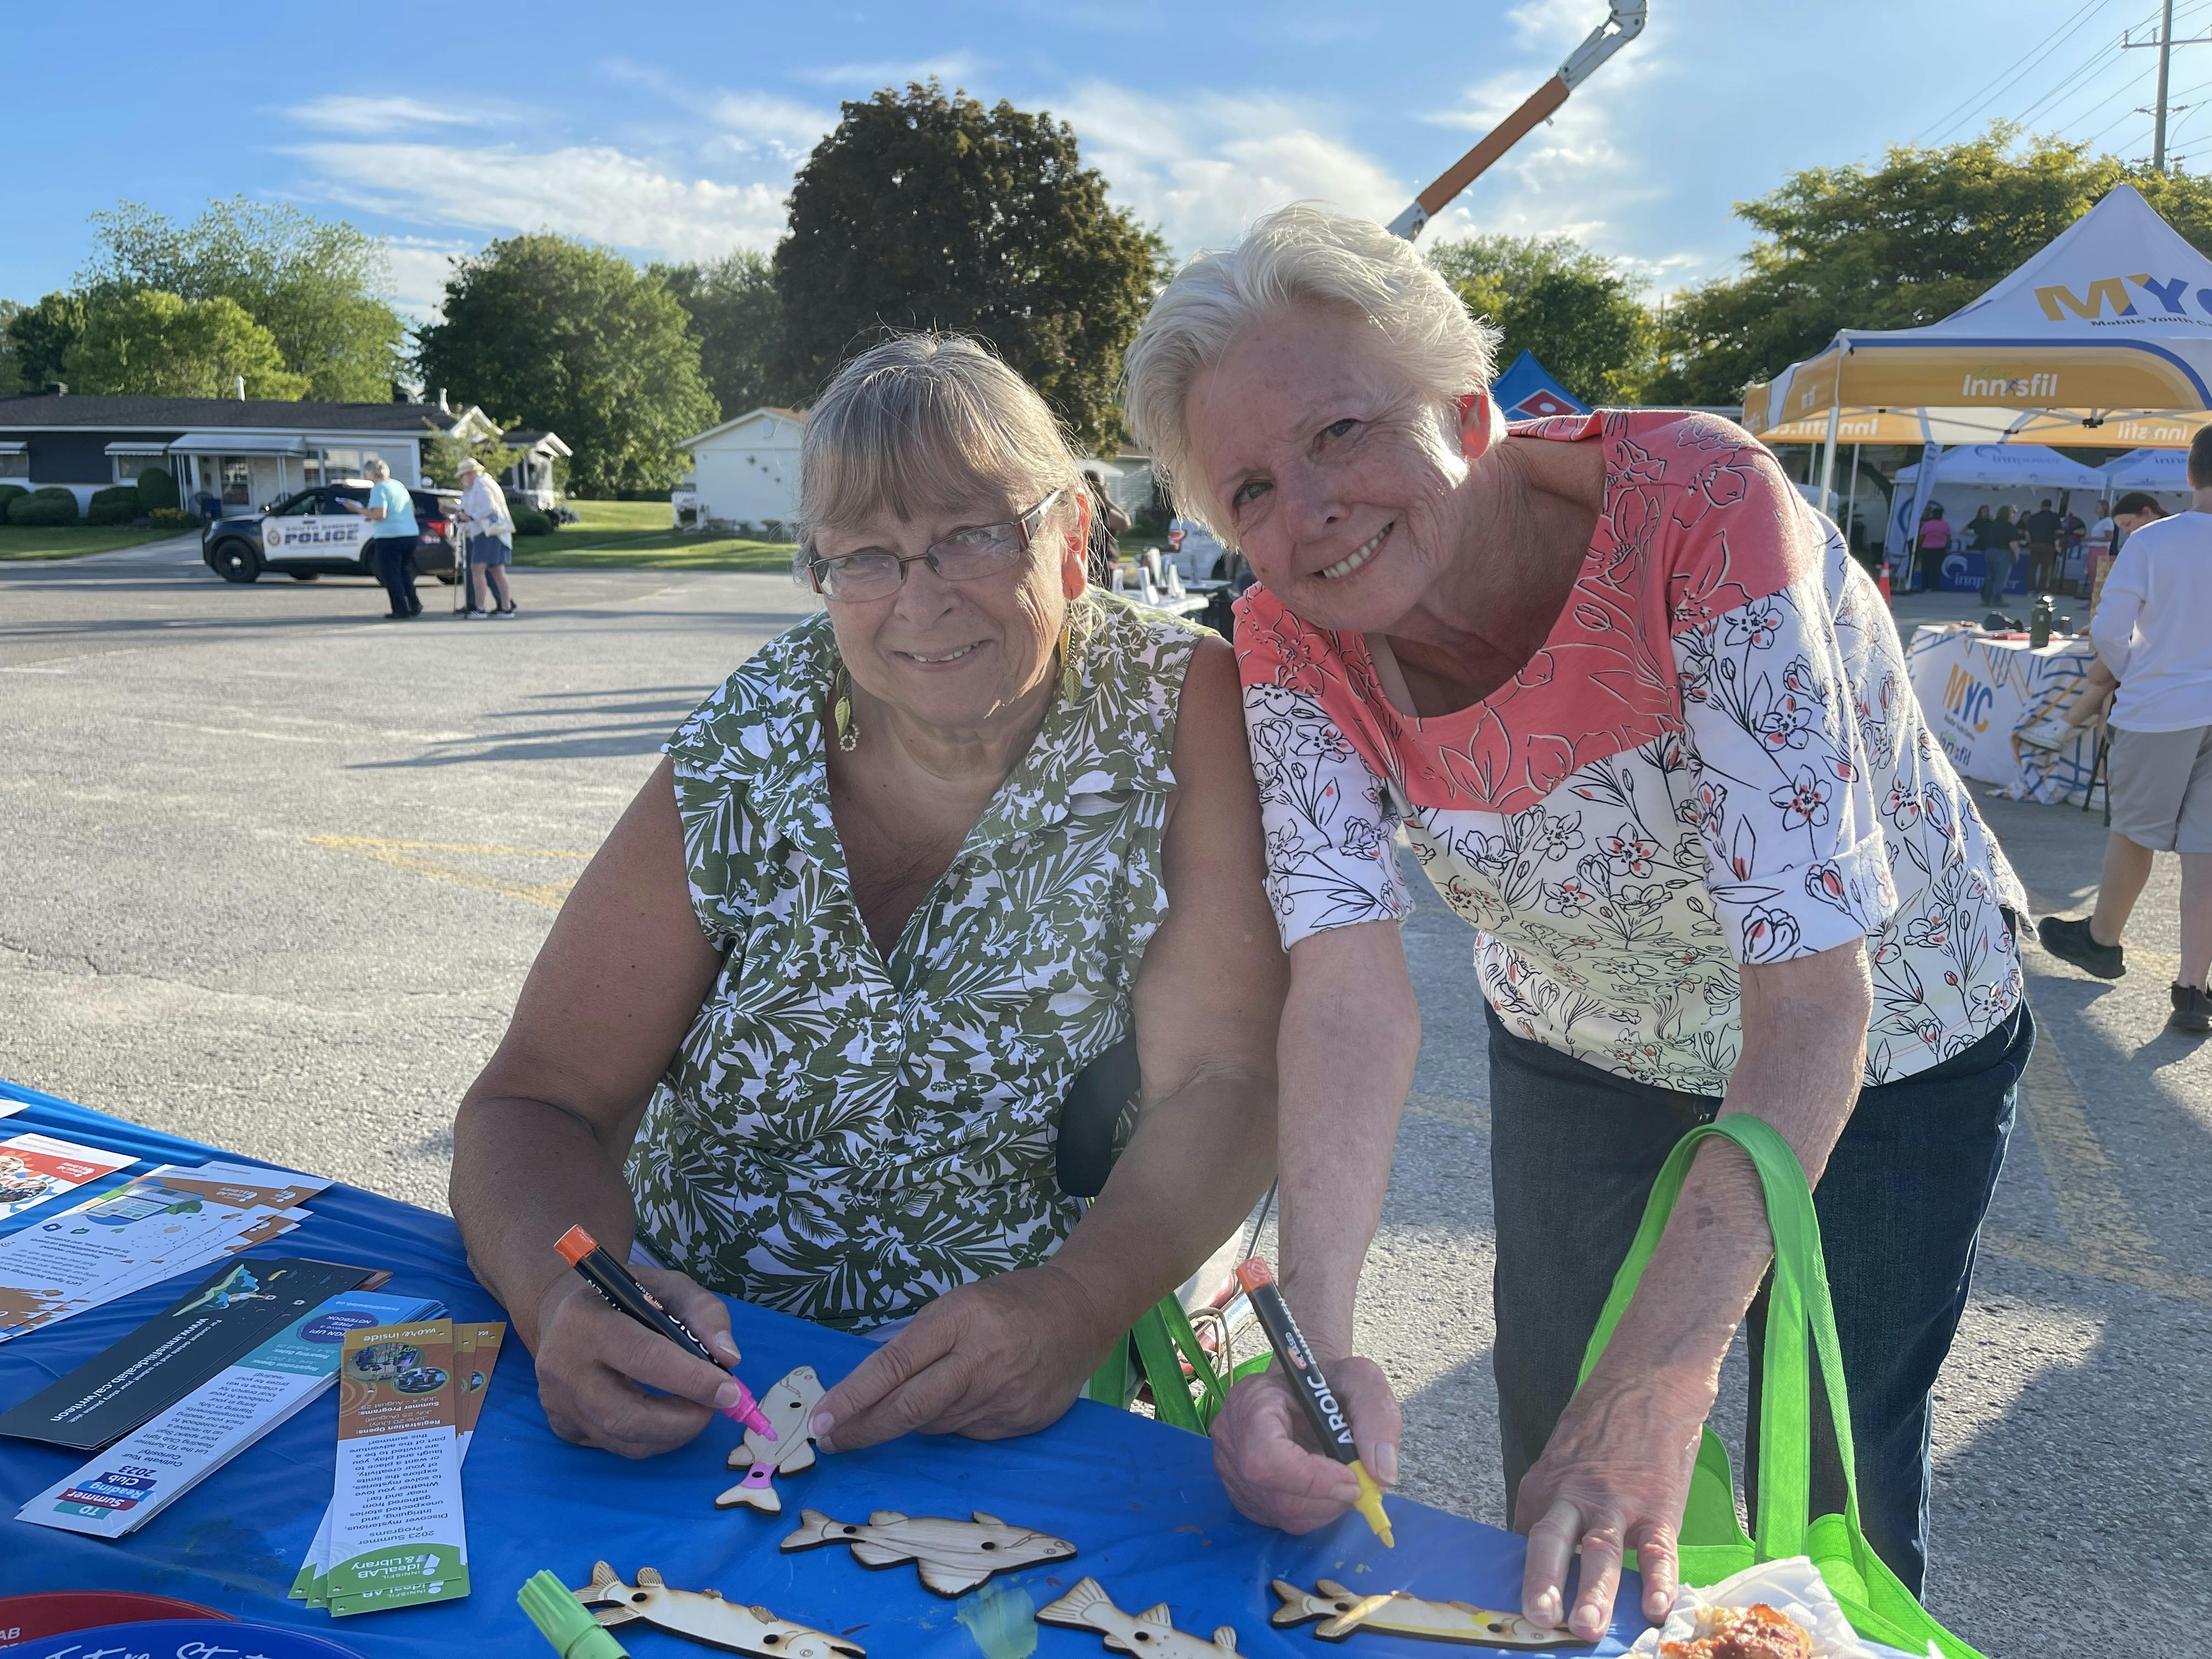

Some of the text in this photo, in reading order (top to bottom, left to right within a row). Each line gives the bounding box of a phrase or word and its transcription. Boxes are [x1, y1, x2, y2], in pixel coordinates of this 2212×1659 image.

[2148, 317, 2194, 325] Youth
[285, 530, 358, 544] POLICE
[1942, 663, 1993, 733] MYC
[326, 1316, 372, 1324] NOTEBOOK
[364, 1328, 436, 1342] more inside
[296, 1351, 330, 1359] Reporting
[50, 1318, 209, 1422] www.innisfilidealab.ca/writeon
[276, 1362, 320, 1372] Registration
[224, 1406, 255, 1414] Starting
[358, 1401, 439, 1415] Summer Programs:
[1307, 1373, 1355, 1444] AROIC
[176, 1411, 206, 1419] reading
[365, 1413, 399, 1422] (August)
[182, 1419, 218, 1427] notebook
[356, 1419, 441, 1435] Registration Opens:
[133, 1440, 167, 1448] Summer
[182, 1439, 215, 1448] Reading
[369, 1436, 408, 1445] summer!
[349, 1444, 396, 1453] adventure
[138, 1449, 181, 1459] Curiosity!
[144, 1457, 183, 1467] Cultivate
[119, 1465, 157, 1477] 2023
[358, 1467, 402, 1476] creativity,
[403, 1469, 438, 1477] explore
[108, 1475, 139, 1486] Club
[353, 1480, 402, 1489] mysteries,
[398, 1481, 438, 1490] Whether
[88, 1481, 145, 1499] Reading
[66, 1491, 125, 1507] Summer
[388, 1495, 431, 1505] gathered
[79, 1506, 100, 1516] TD
[350, 1500, 443, 1517] unexpected stories
[383, 1509, 432, 1519] intriguing,
[345, 1513, 448, 1531] Discover mysterious,
[369, 1526, 423, 1537] Programs
[358, 1531, 435, 1545] 2023 Summer
[351, 1558, 402, 1570] Library
[358, 1563, 420, 1578] ideaLAB
[382, 1570, 421, 1579] INNISFIL
[387, 1588, 426, 1598] INNISFIL
